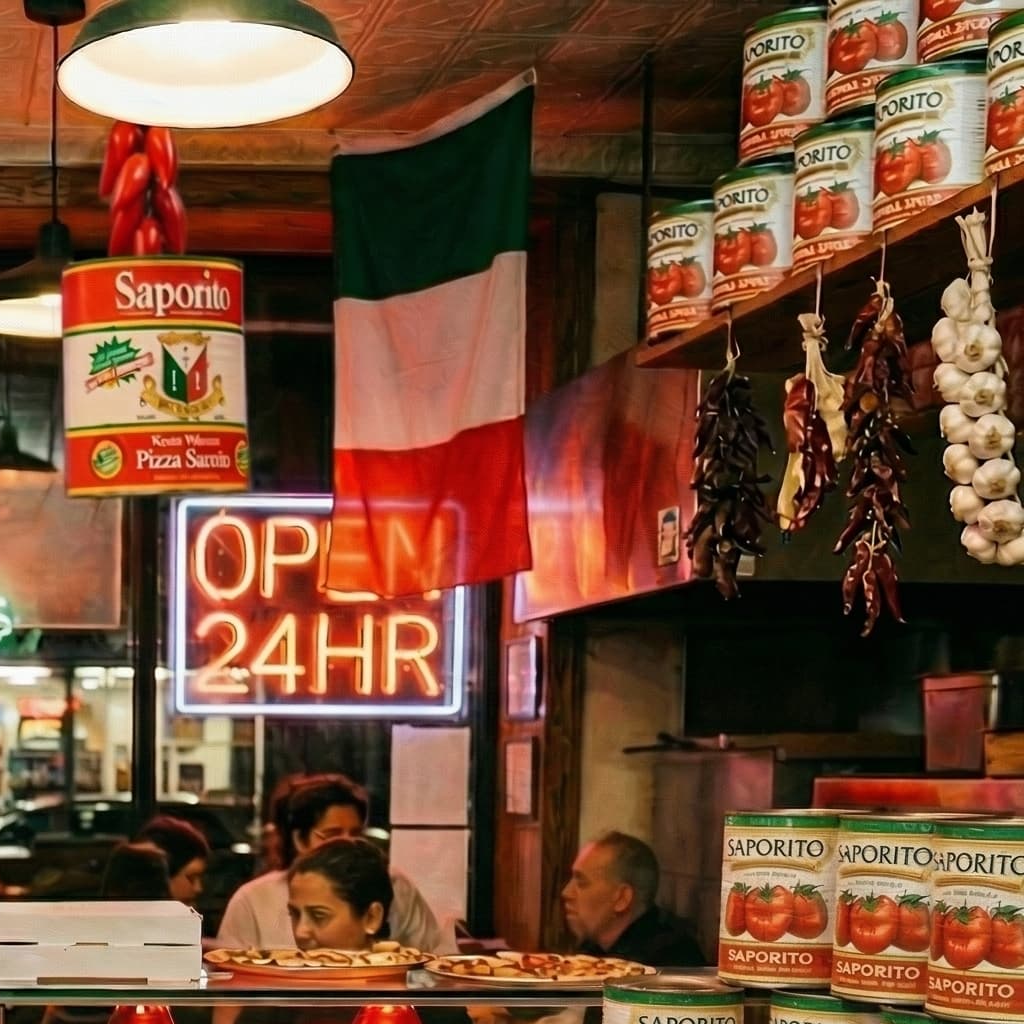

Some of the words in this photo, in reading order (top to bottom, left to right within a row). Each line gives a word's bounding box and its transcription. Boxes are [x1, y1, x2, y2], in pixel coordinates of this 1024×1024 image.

[115, 270, 230, 317] Saporito
[195, 612, 440, 697] 24HR
[728, 838, 824, 859] SAPORITO
[838, 844, 933, 867] SAPORITO
[728, 949, 814, 966] SAPORITO
[836, 960, 921, 979] SAPORITO
[929, 975, 1016, 999] SAPORITO
